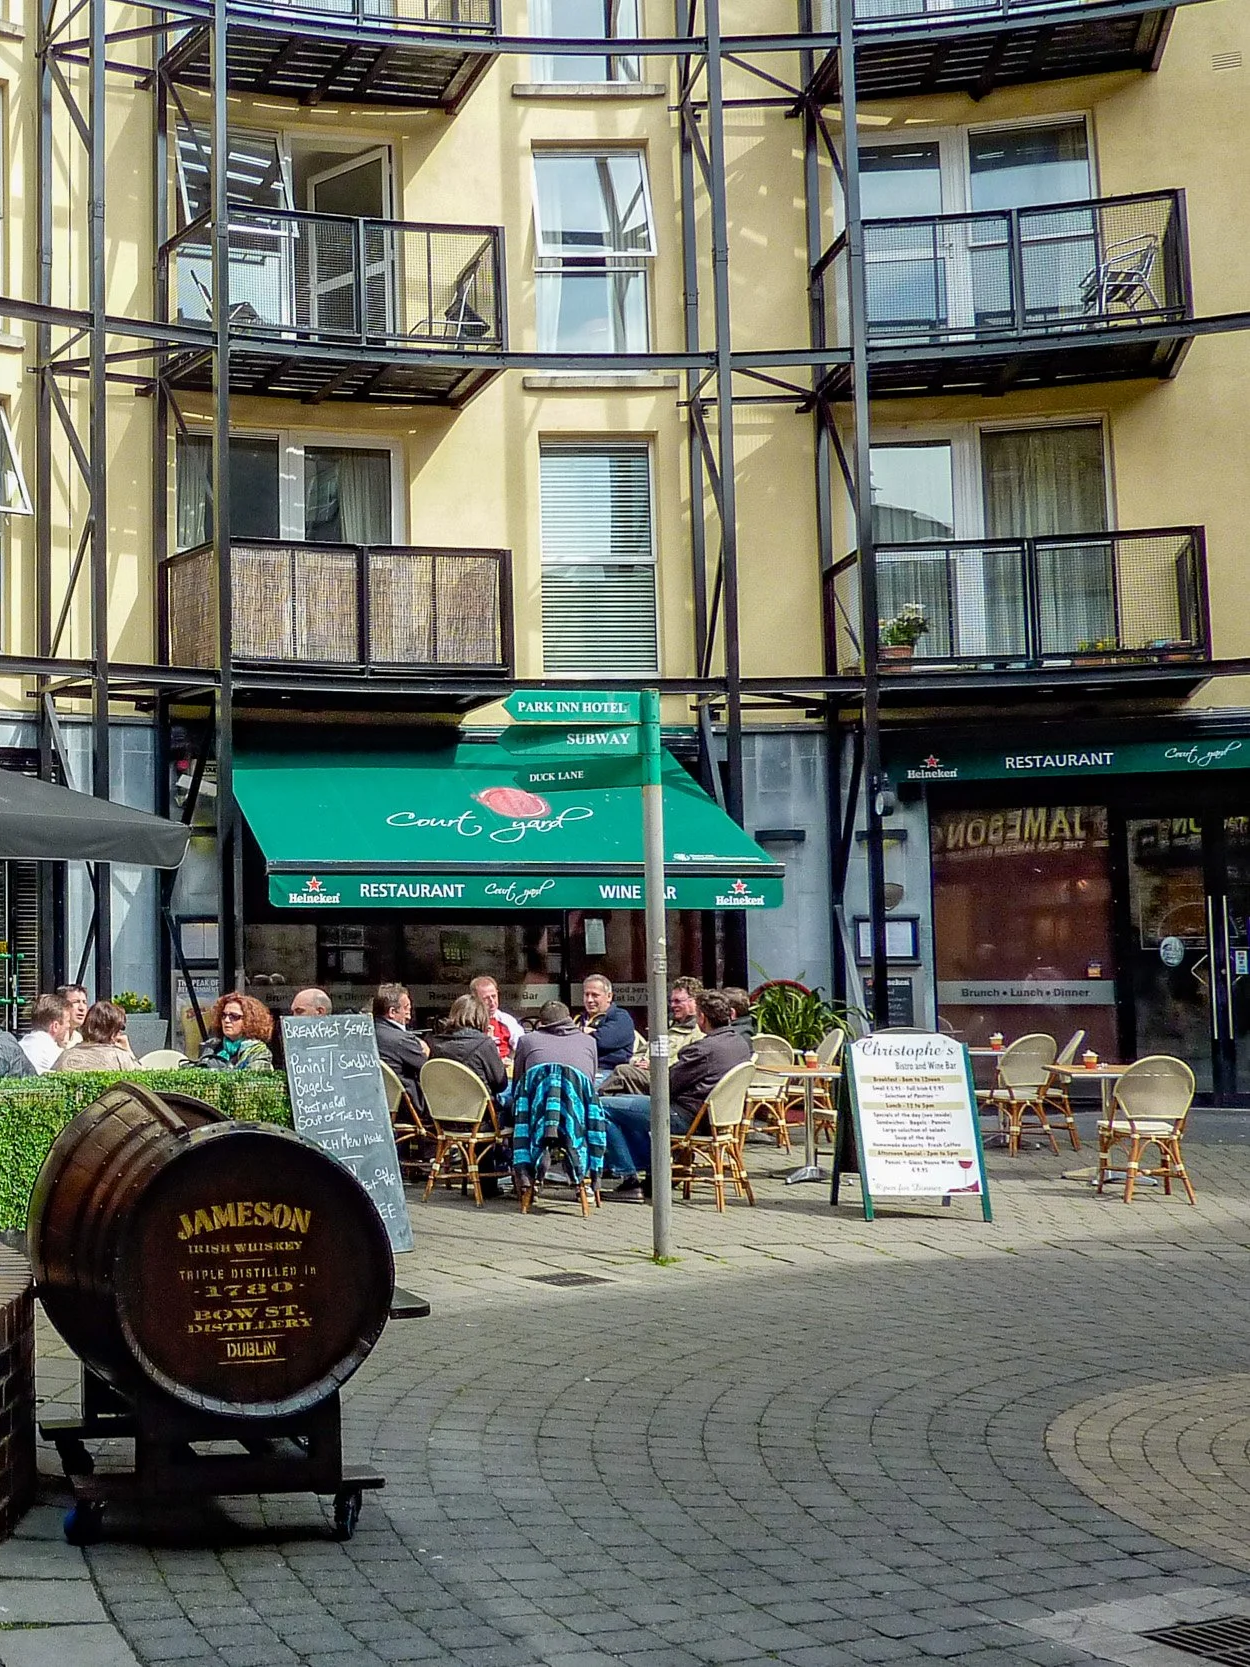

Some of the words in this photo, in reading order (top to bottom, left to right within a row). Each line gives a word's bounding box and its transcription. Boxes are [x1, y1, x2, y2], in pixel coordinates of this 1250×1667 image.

[517, 701, 553, 713] PARK
[556, 701, 580, 713] INN
[581, 702, 628, 713] HOTEL
[566, 732, 631, 745] SUBWAY
[1005, 752, 1114, 769] RESTAURANT
[529, 772, 555, 782] DUCK
[558, 770, 584, 780] LANE
[907, 768, 958, 779] Heineken
[386, 810, 483, 837] Court
[489, 806, 594, 843] yard
[360, 883, 465, 898] RESTAURANT
[484, 881, 517, 901] Court
[598, 885, 641, 899] WINE
[288, 892, 341, 904] Heineken
[715, 894, 765, 906] Heineken
[191, 979, 209, 987] PEAK
[210, 979, 219, 987] OF
[522, 991, 539, 1000] Bar
[961, 988, 1000, 997] Brunch
[1010, 988, 1043, 997] Lunch
[1053, 988, 1091, 997] Dinner
[856, 1040, 955, 1061] Christophe's
[291, 1053, 325, 1075] Panini
[915, 1061, 926, 1070] and
[927, 1061, 944, 1070] Wine
[945, 1060, 956, 1070] Bar
[294, 1075, 334, 1097] Bagels
[177, 1201, 311, 1240] JAMESON
[188, 1243, 230, 1254] IRISH
[234, 1241, 303, 1253] WHISKEY
[179, 1268, 224, 1280] TRIPLE
[231, 1265, 297, 1279] DISTILLED
[193, 1307, 259, 1321] BOW
[265, 1304, 305, 1317] ST.
[188, 1317, 313, 1333] DISTILLERY
[227, 1341, 277, 1358] DUBLIN
